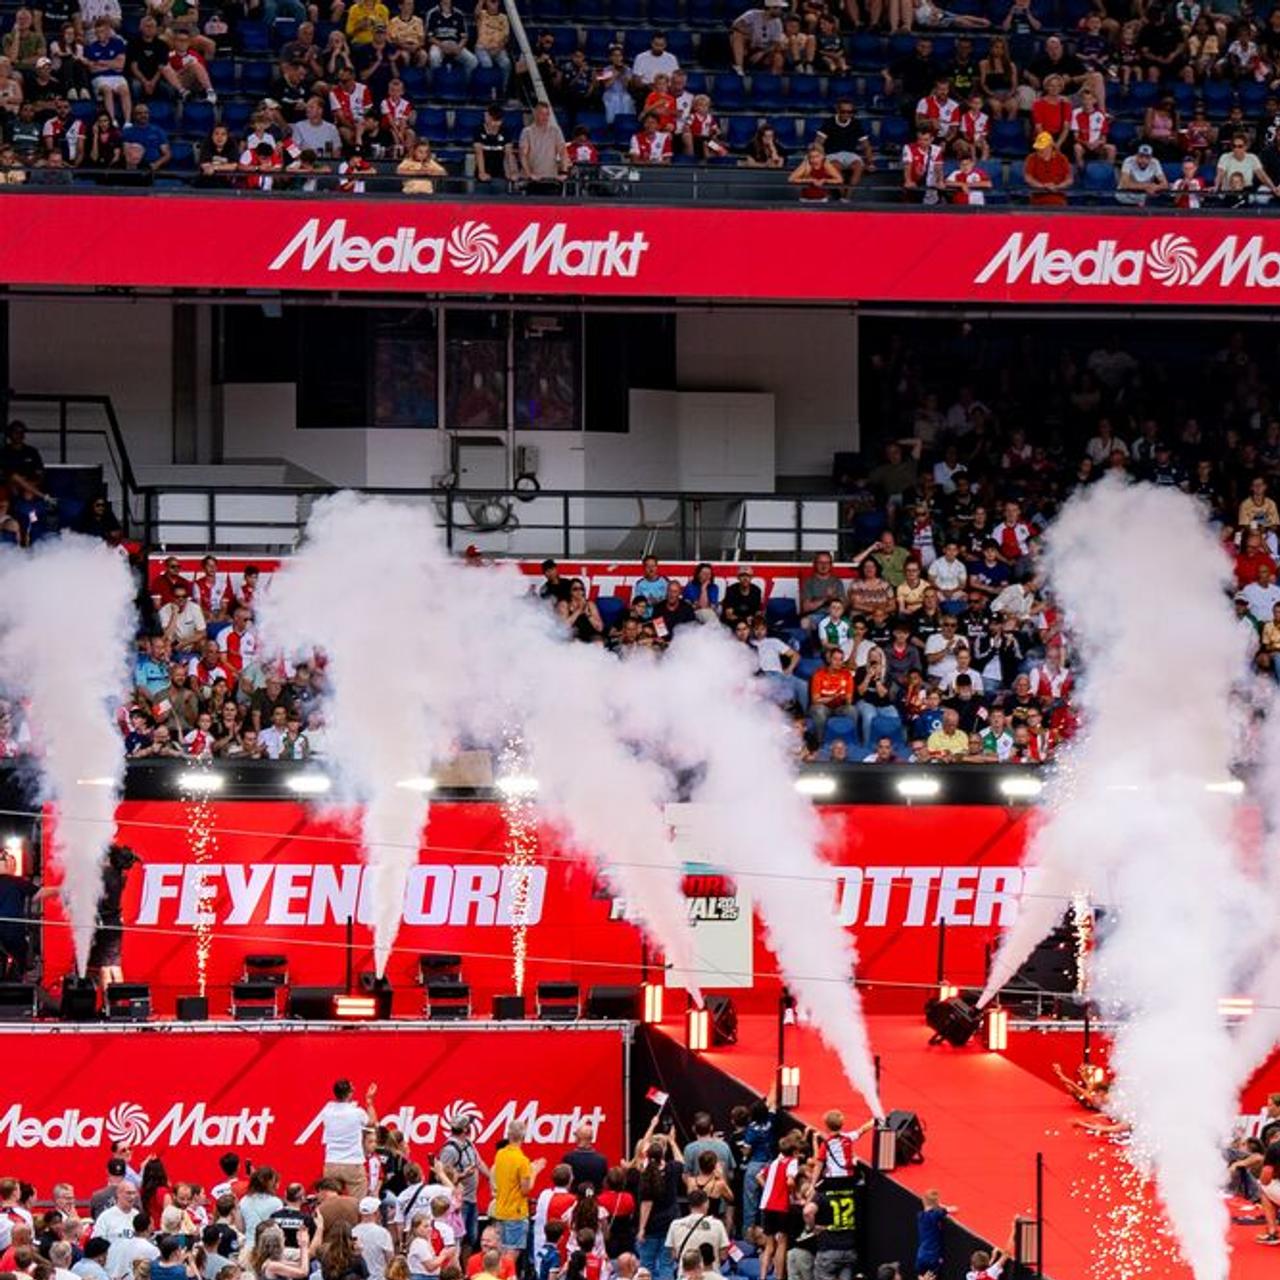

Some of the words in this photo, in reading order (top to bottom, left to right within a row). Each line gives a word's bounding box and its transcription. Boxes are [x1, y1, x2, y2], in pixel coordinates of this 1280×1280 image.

[268, 218, 444, 274] Media
[490, 222, 649, 278] Markt
[974, 232, 1143, 285] Media
[135, 863, 548, 927] FEYENORD
[141, 1102, 275, 1147] Markt
[475, 1100, 606, 1145] Markt
[829, 1198, 855, 1227] 12
